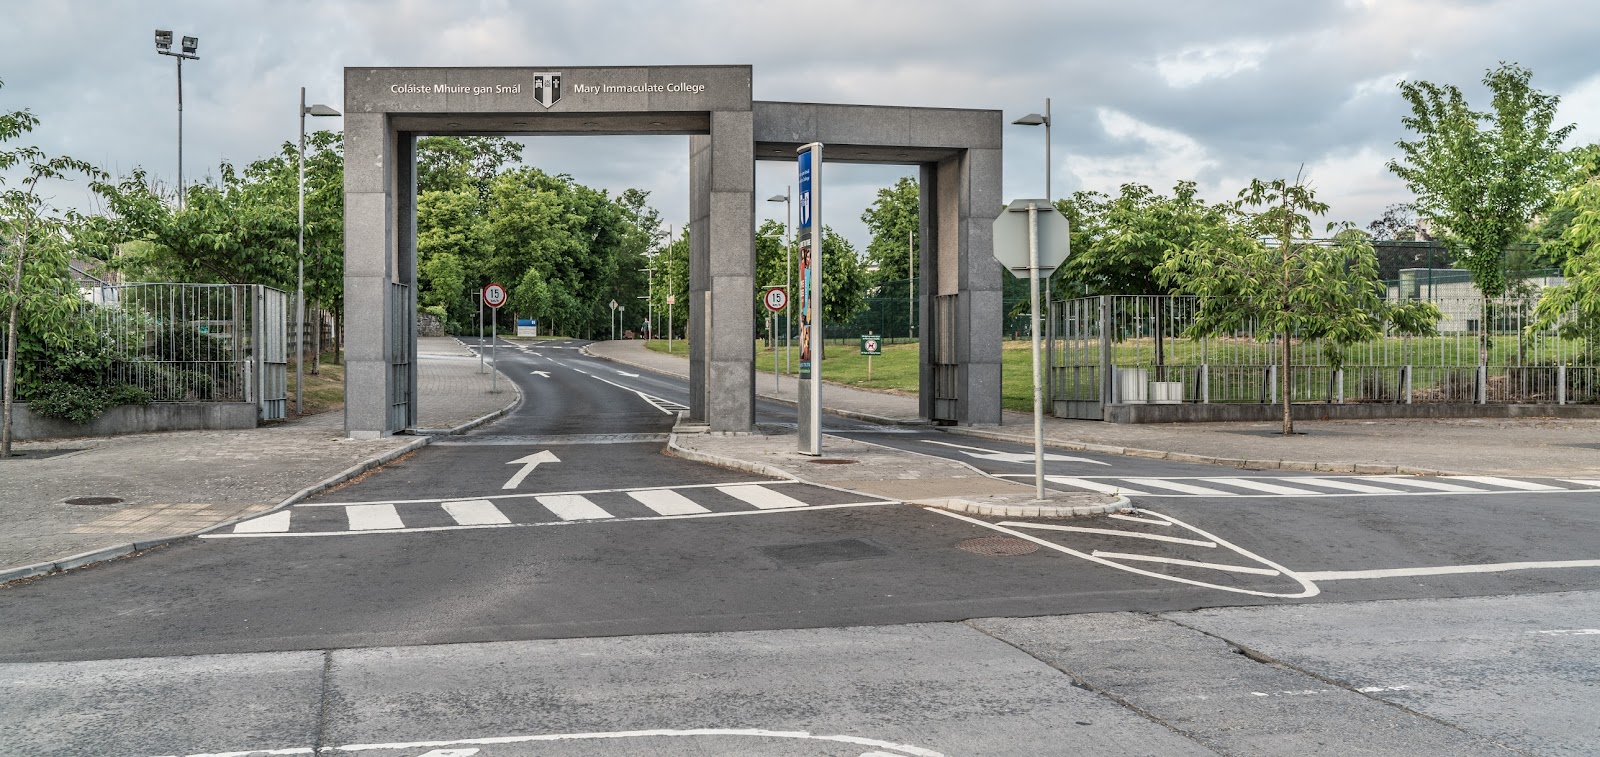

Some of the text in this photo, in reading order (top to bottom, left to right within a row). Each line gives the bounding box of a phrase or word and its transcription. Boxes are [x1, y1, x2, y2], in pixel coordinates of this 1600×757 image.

[391, 84, 521, 96] Coláiste Mhuire gan Smál
[574, 82, 705, 95] Mary Immaculate College
[490, 289, 500, 298] 15
[772, 293, 781, 303] 15
